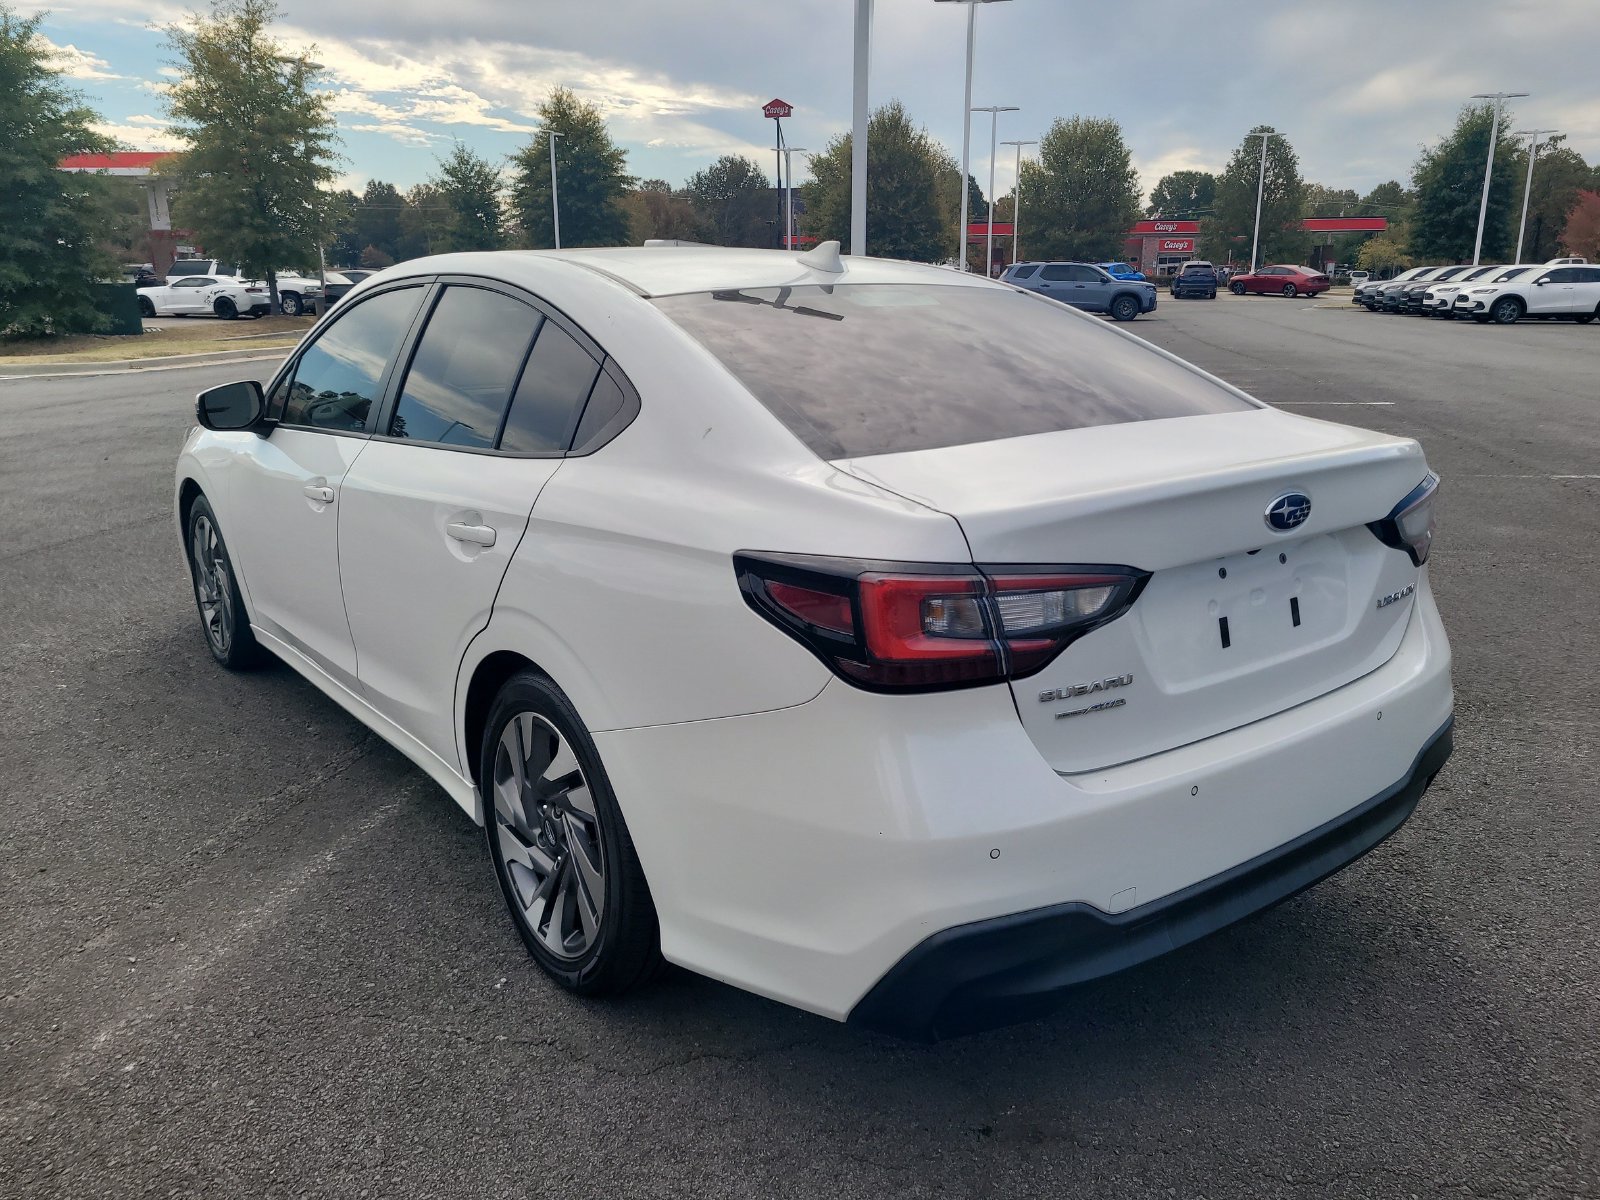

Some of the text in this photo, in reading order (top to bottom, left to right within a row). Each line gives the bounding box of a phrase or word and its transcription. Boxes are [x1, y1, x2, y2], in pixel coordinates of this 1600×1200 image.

[765, 105, 789, 116] Casey's
[1154, 222, 1178, 232] Casey's
[1164, 240, 1189, 250] Casey's
[1039, 673, 1134, 702] SUBARU
